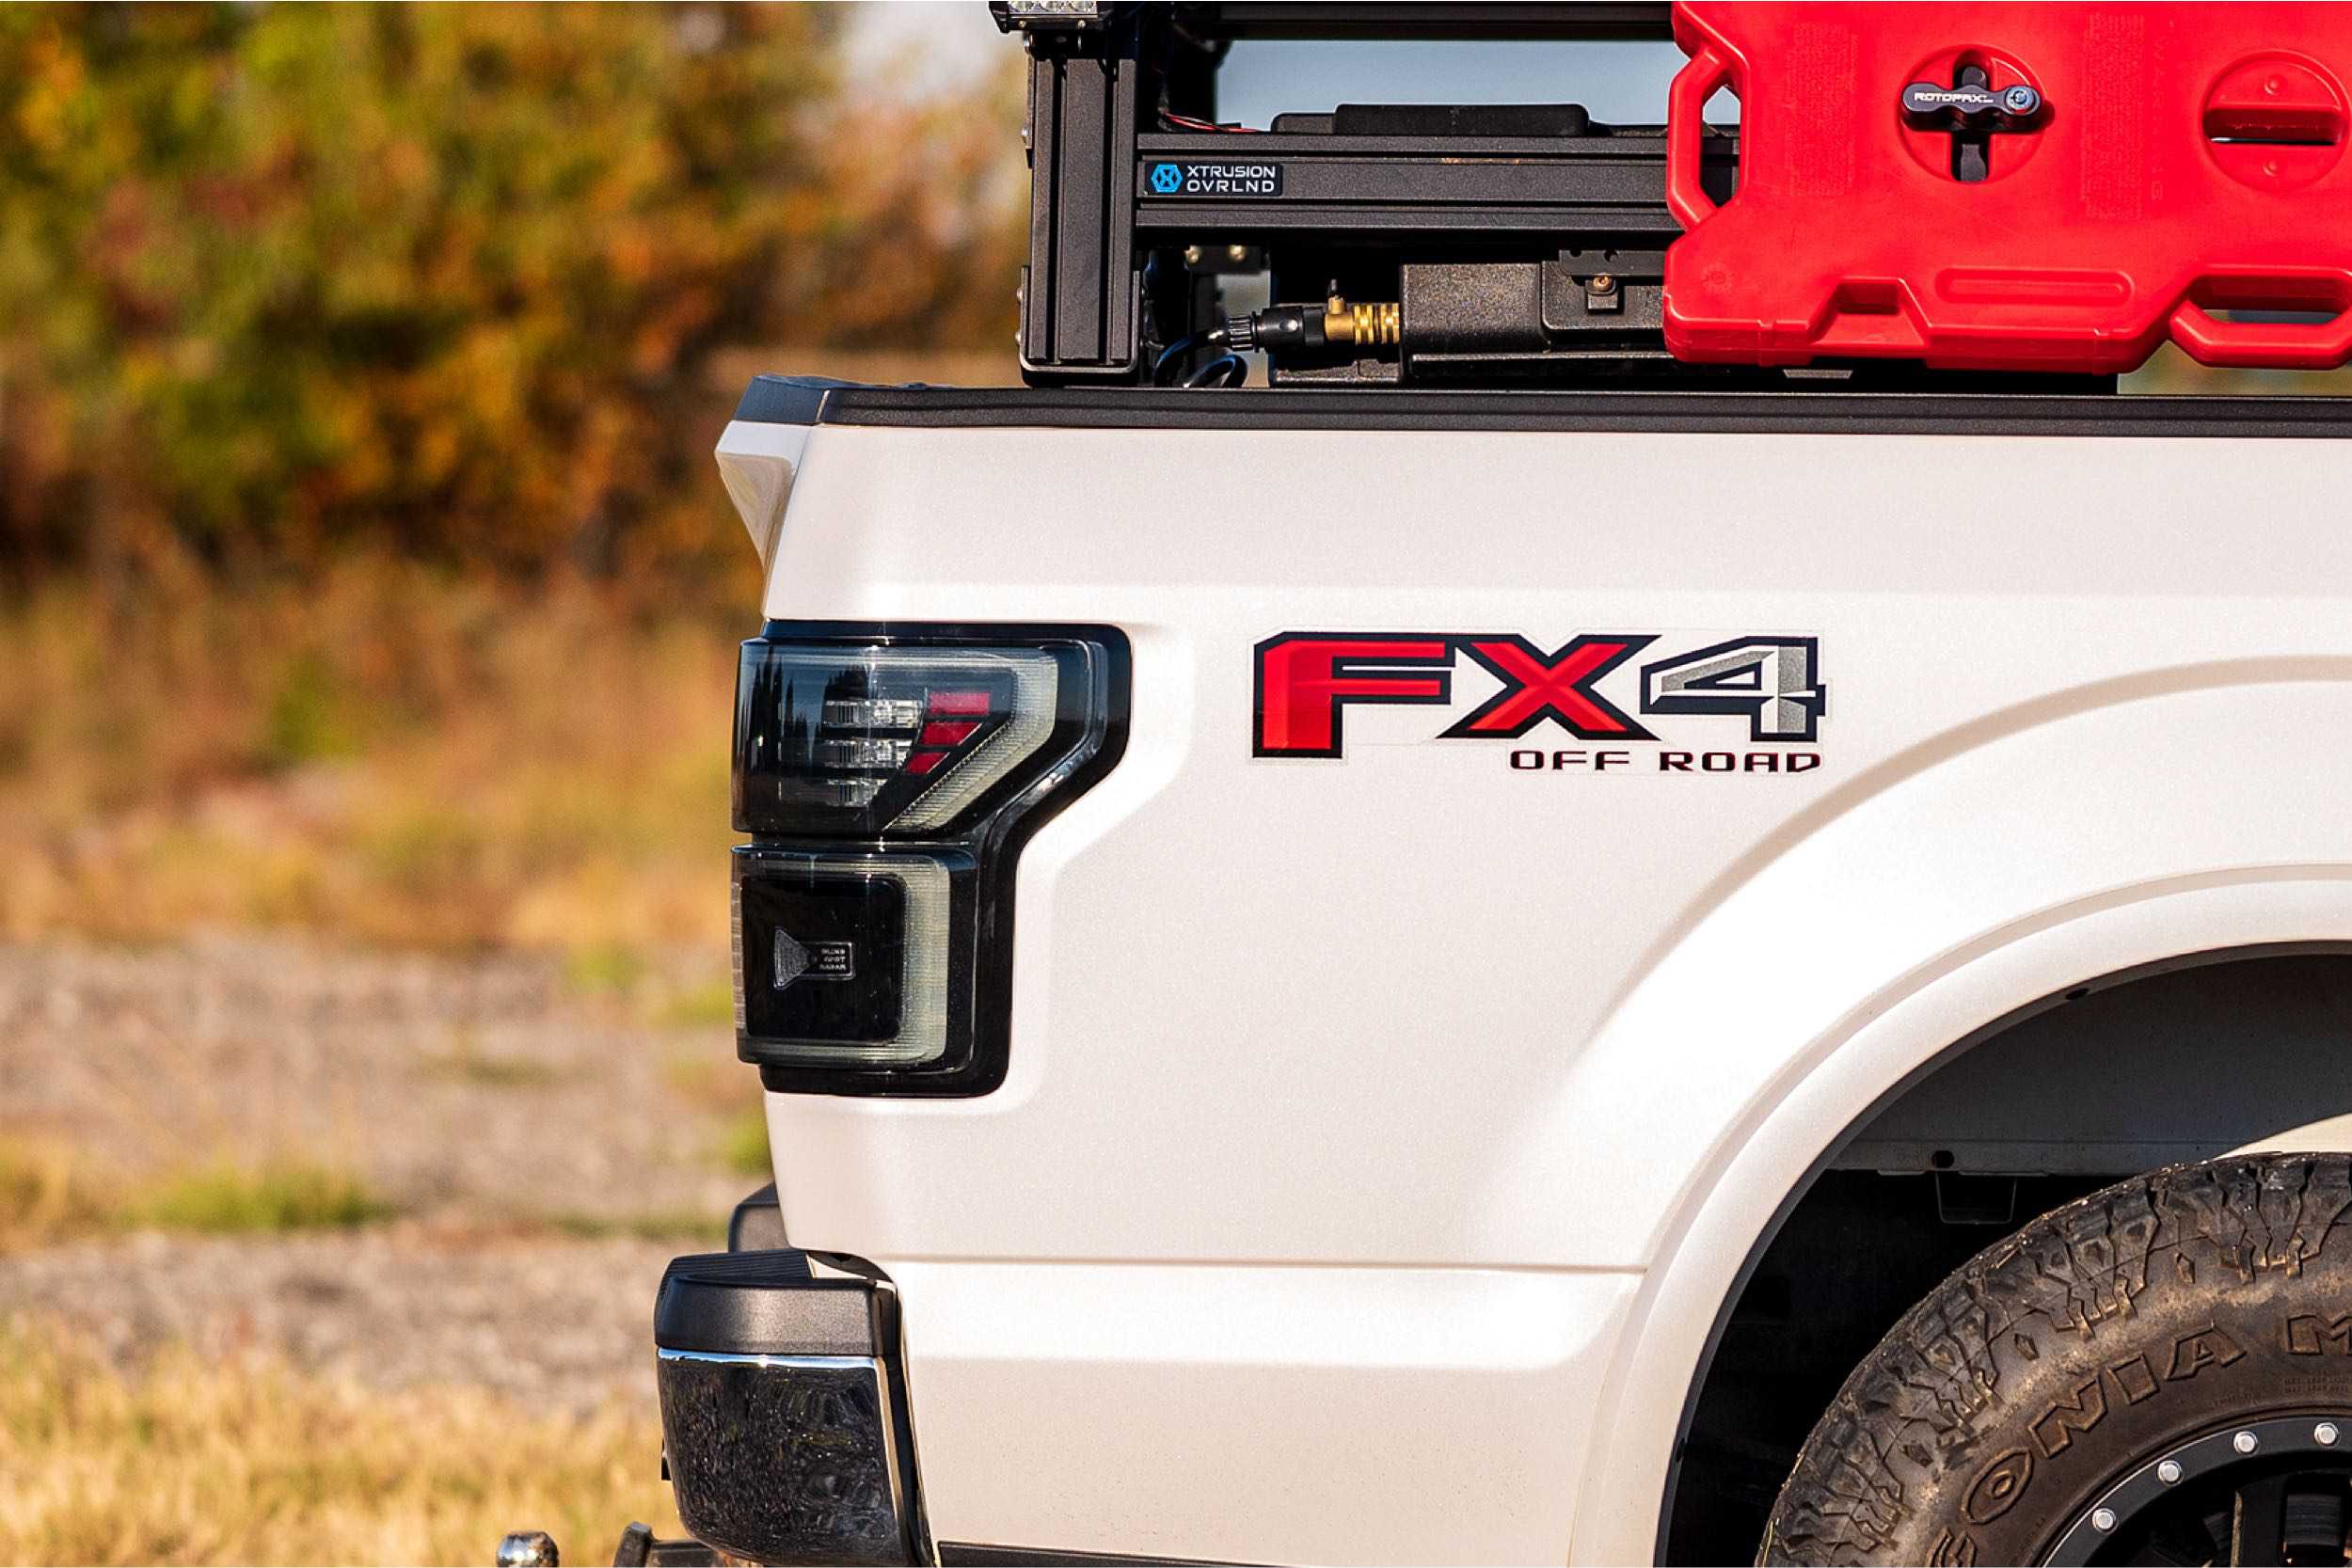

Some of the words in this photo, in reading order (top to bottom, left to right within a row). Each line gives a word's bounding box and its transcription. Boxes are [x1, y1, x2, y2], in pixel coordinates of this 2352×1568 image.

[1186, 165, 1276, 178] XTRUSION
[1186, 180, 1275, 193] OVRLND
[1252, 631, 1826, 758] FX4
[1509, 749, 1630, 770] OFF
[1659, 751, 1821, 773] ROAD
